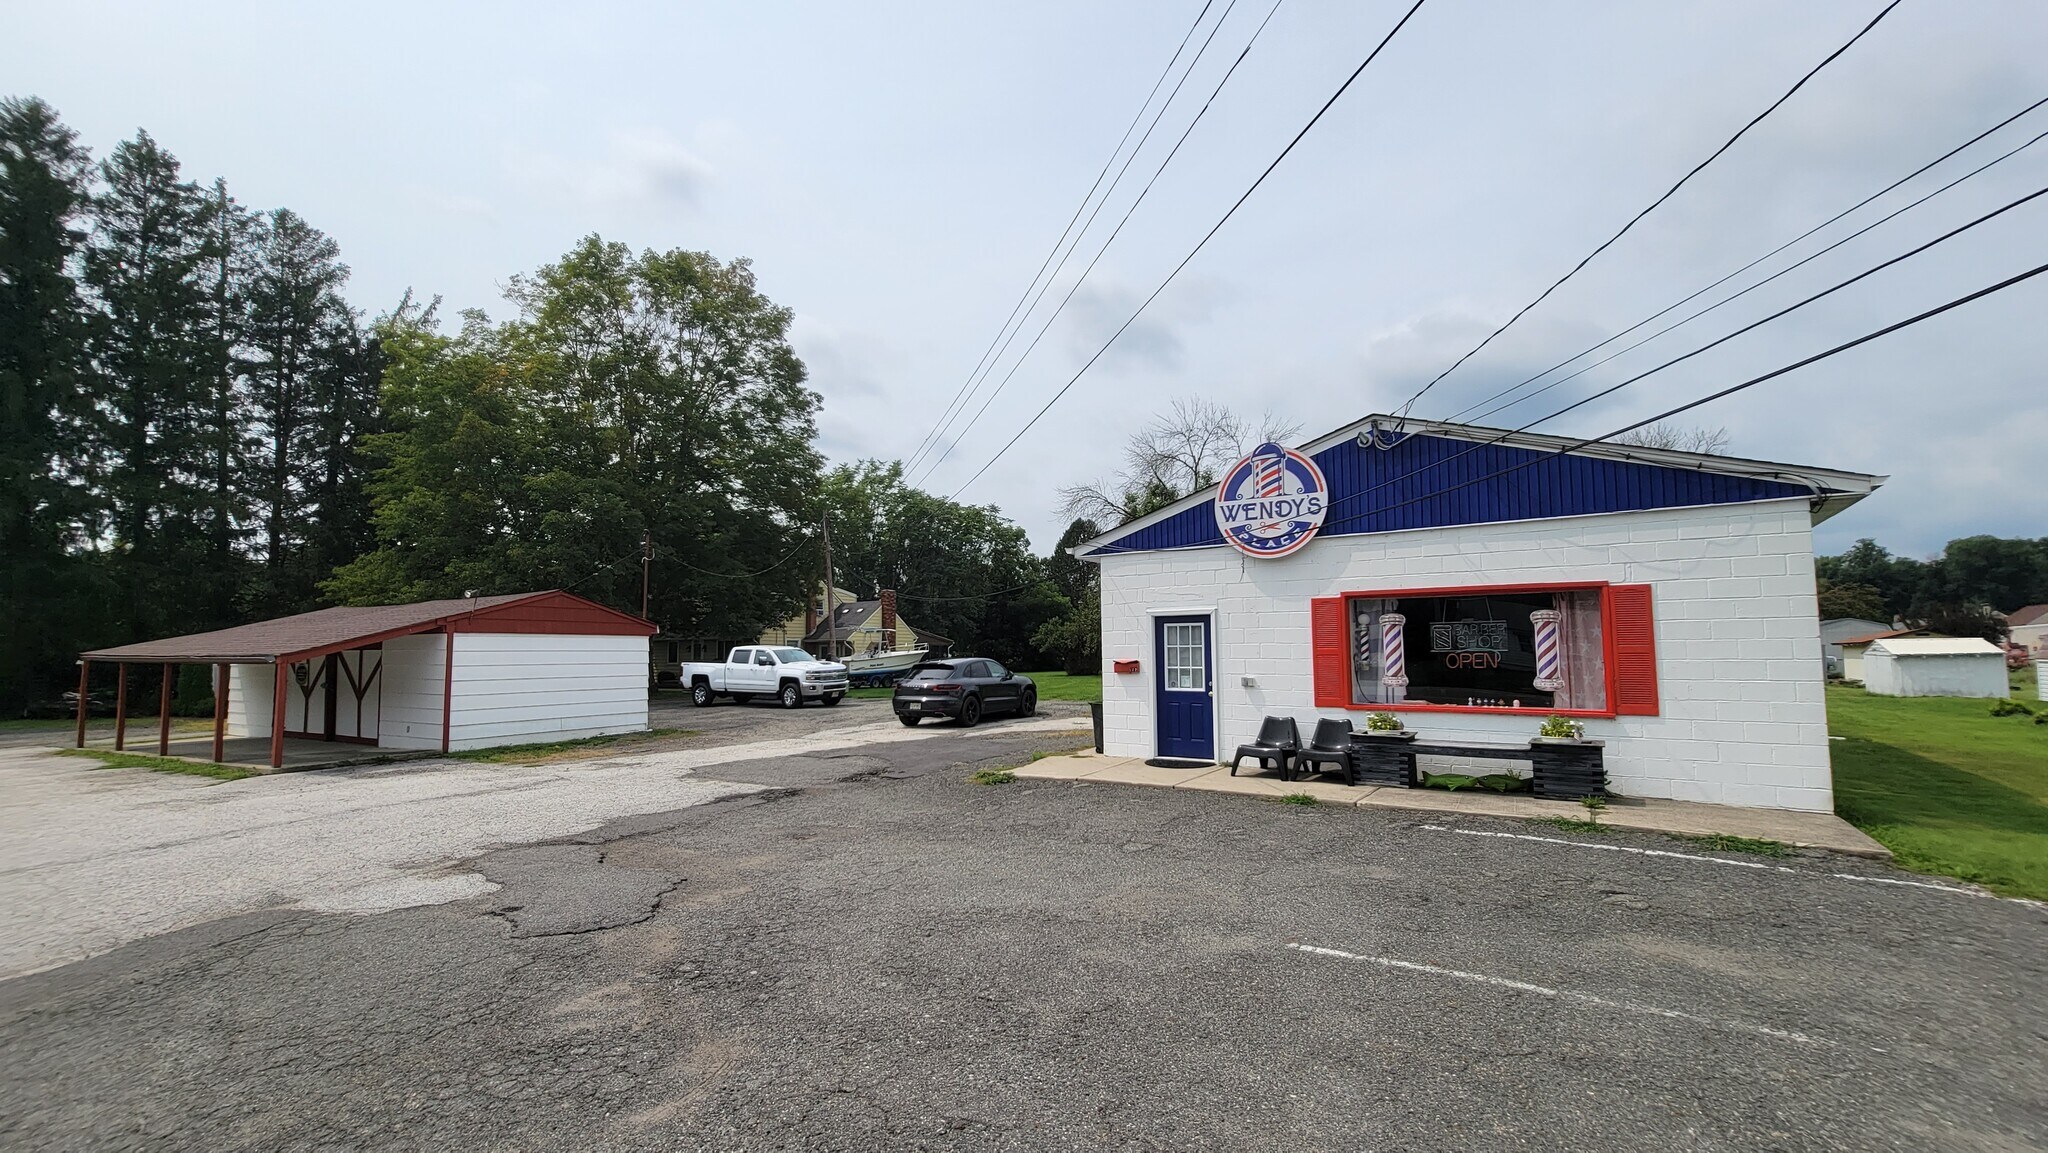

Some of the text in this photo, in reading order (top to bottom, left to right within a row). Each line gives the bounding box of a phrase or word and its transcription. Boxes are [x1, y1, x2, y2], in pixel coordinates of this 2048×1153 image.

[1219, 495, 1322, 523] WENDY'S
[1453, 623, 1505, 636] BARBER
[1456, 635, 1502, 648] SHOP
[1446, 652, 1498, 669] OPEN
